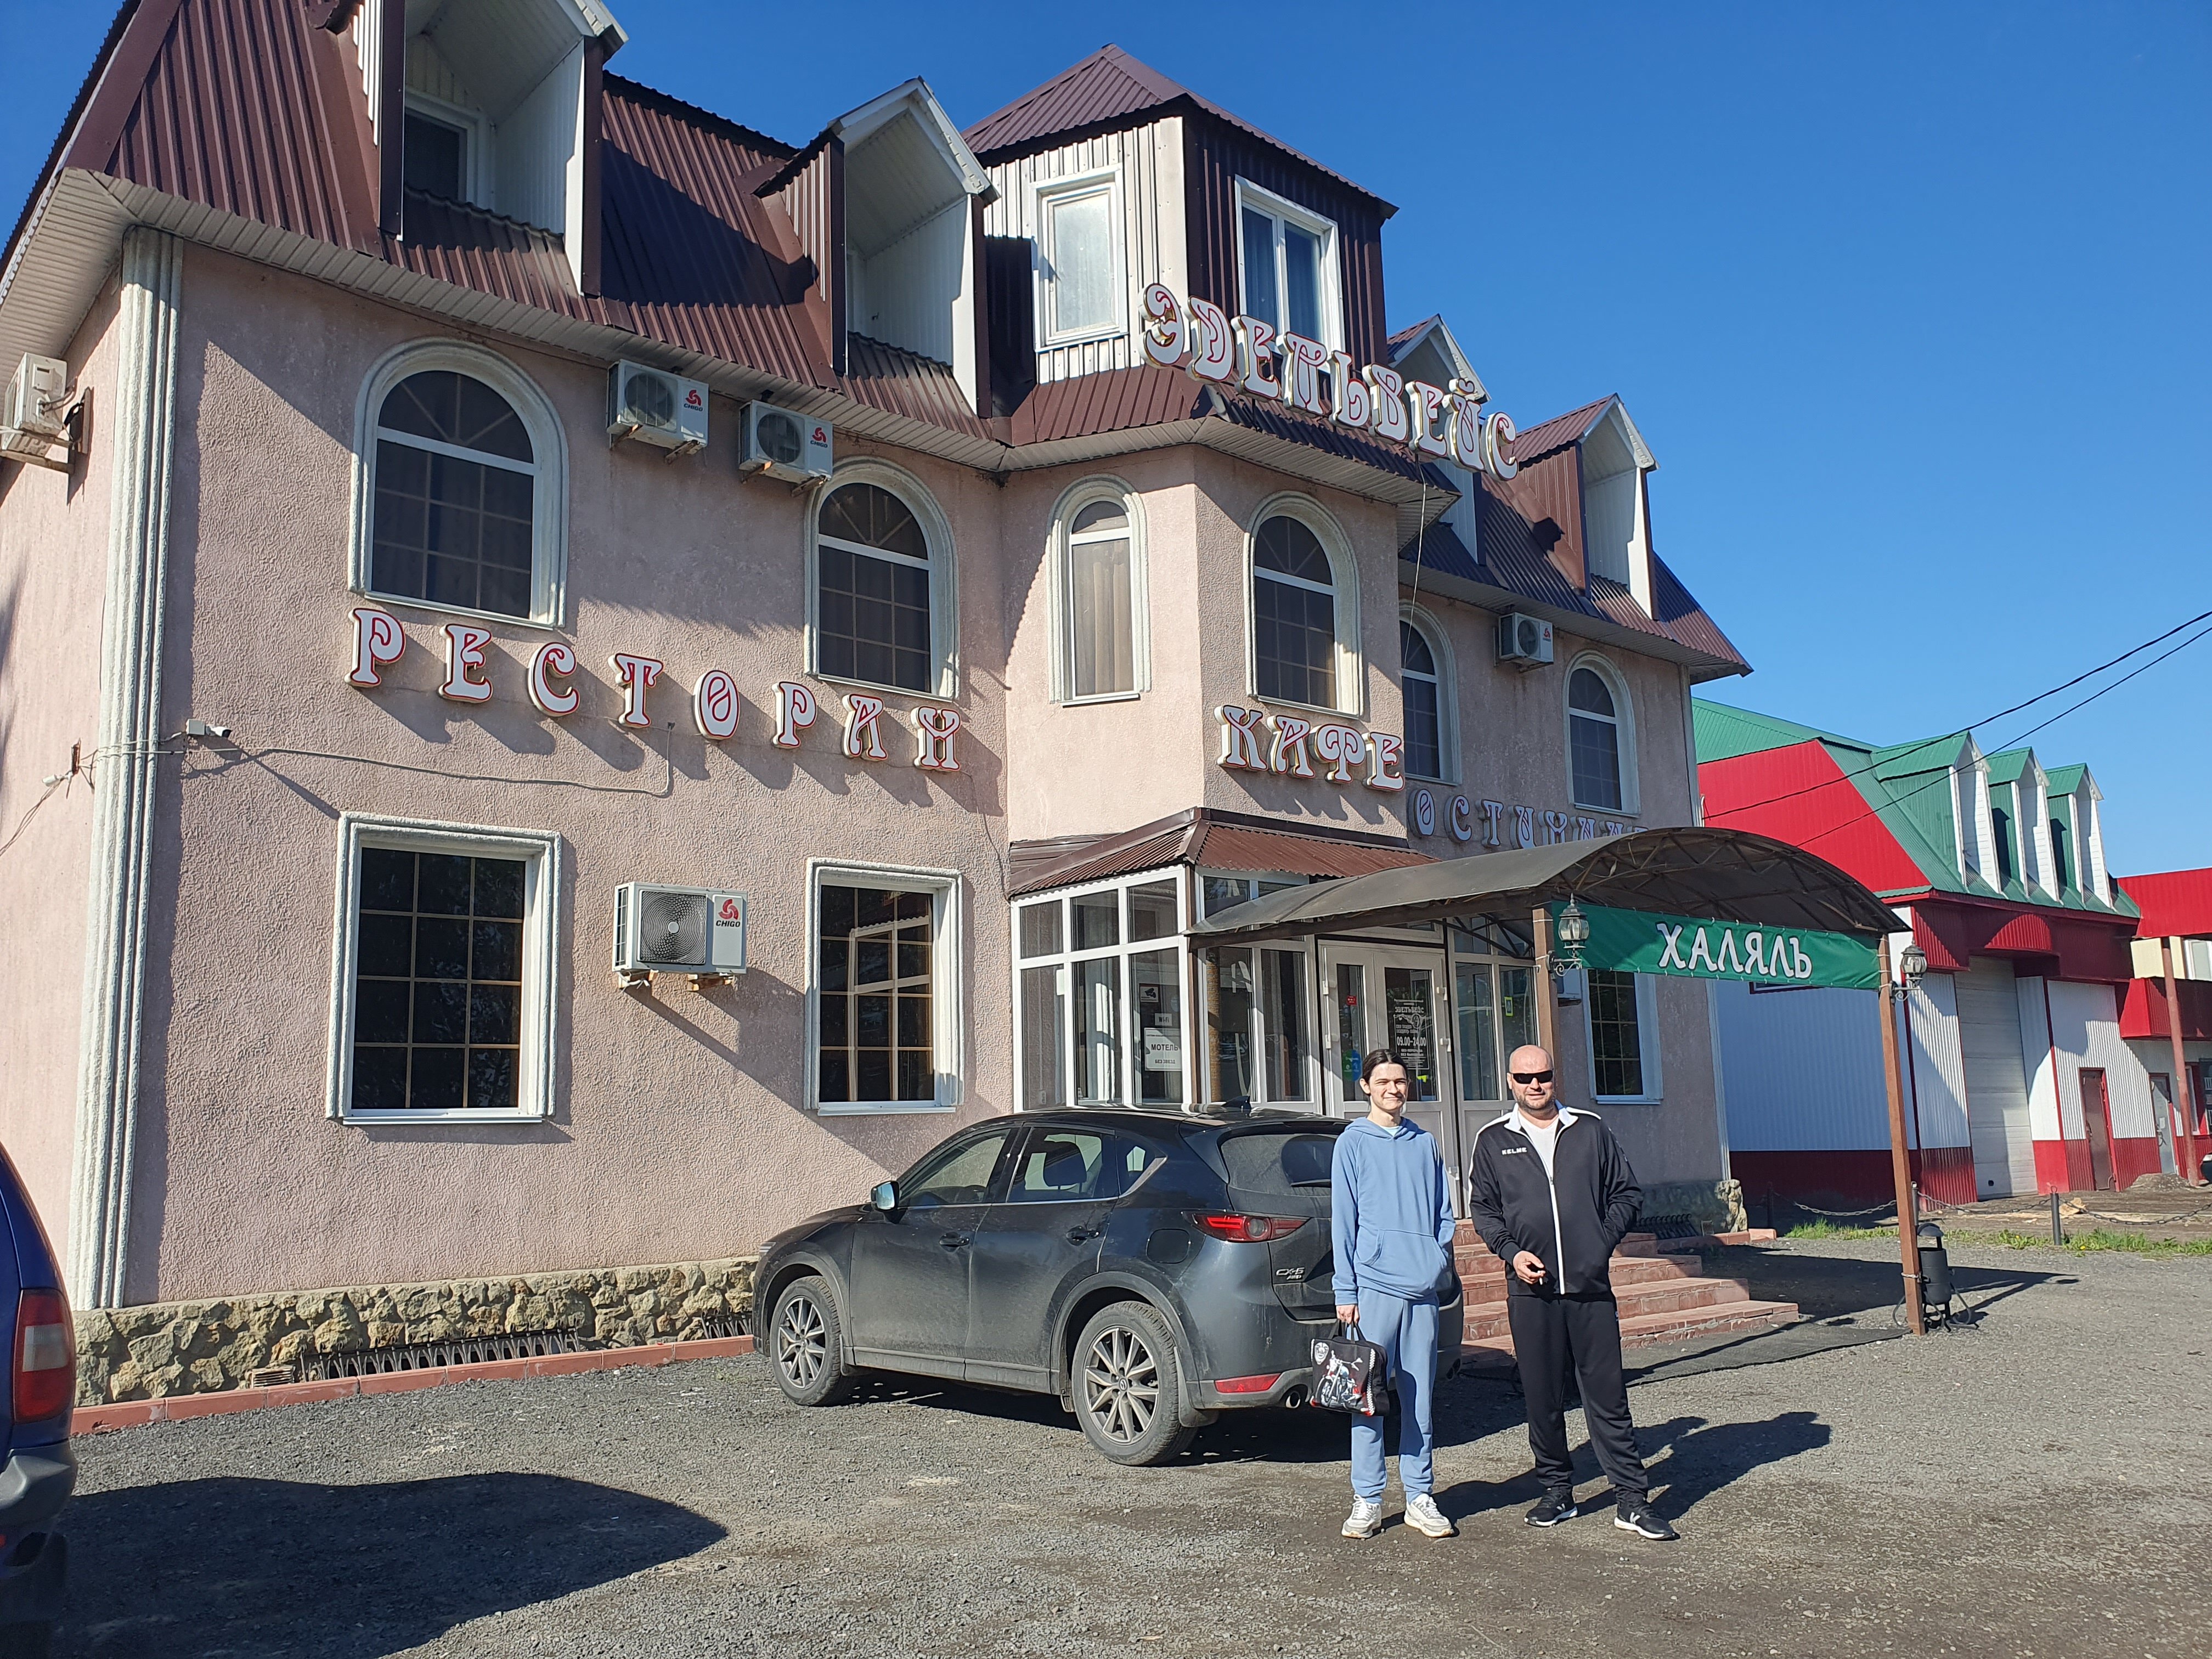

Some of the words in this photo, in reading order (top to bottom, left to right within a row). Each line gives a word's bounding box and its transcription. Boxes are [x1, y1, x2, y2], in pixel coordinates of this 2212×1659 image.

[683, 403, 703, 411] CHIGO
[1138, 283, 1519, 482] ЭДЕЛЬВЕЙС
[345, 608, 961, 772] РЕСТОРАН
[1214, 704, 1405, 792] КАФЕ
[1408, 788, 1649, 849] ОСТИНИ
[716, 919, 741, 928] CHIGO
[1656, 923, 1812, 979] ХАЛЯЛЬ
[1276, 1267, 1305, 1276] CX-5
